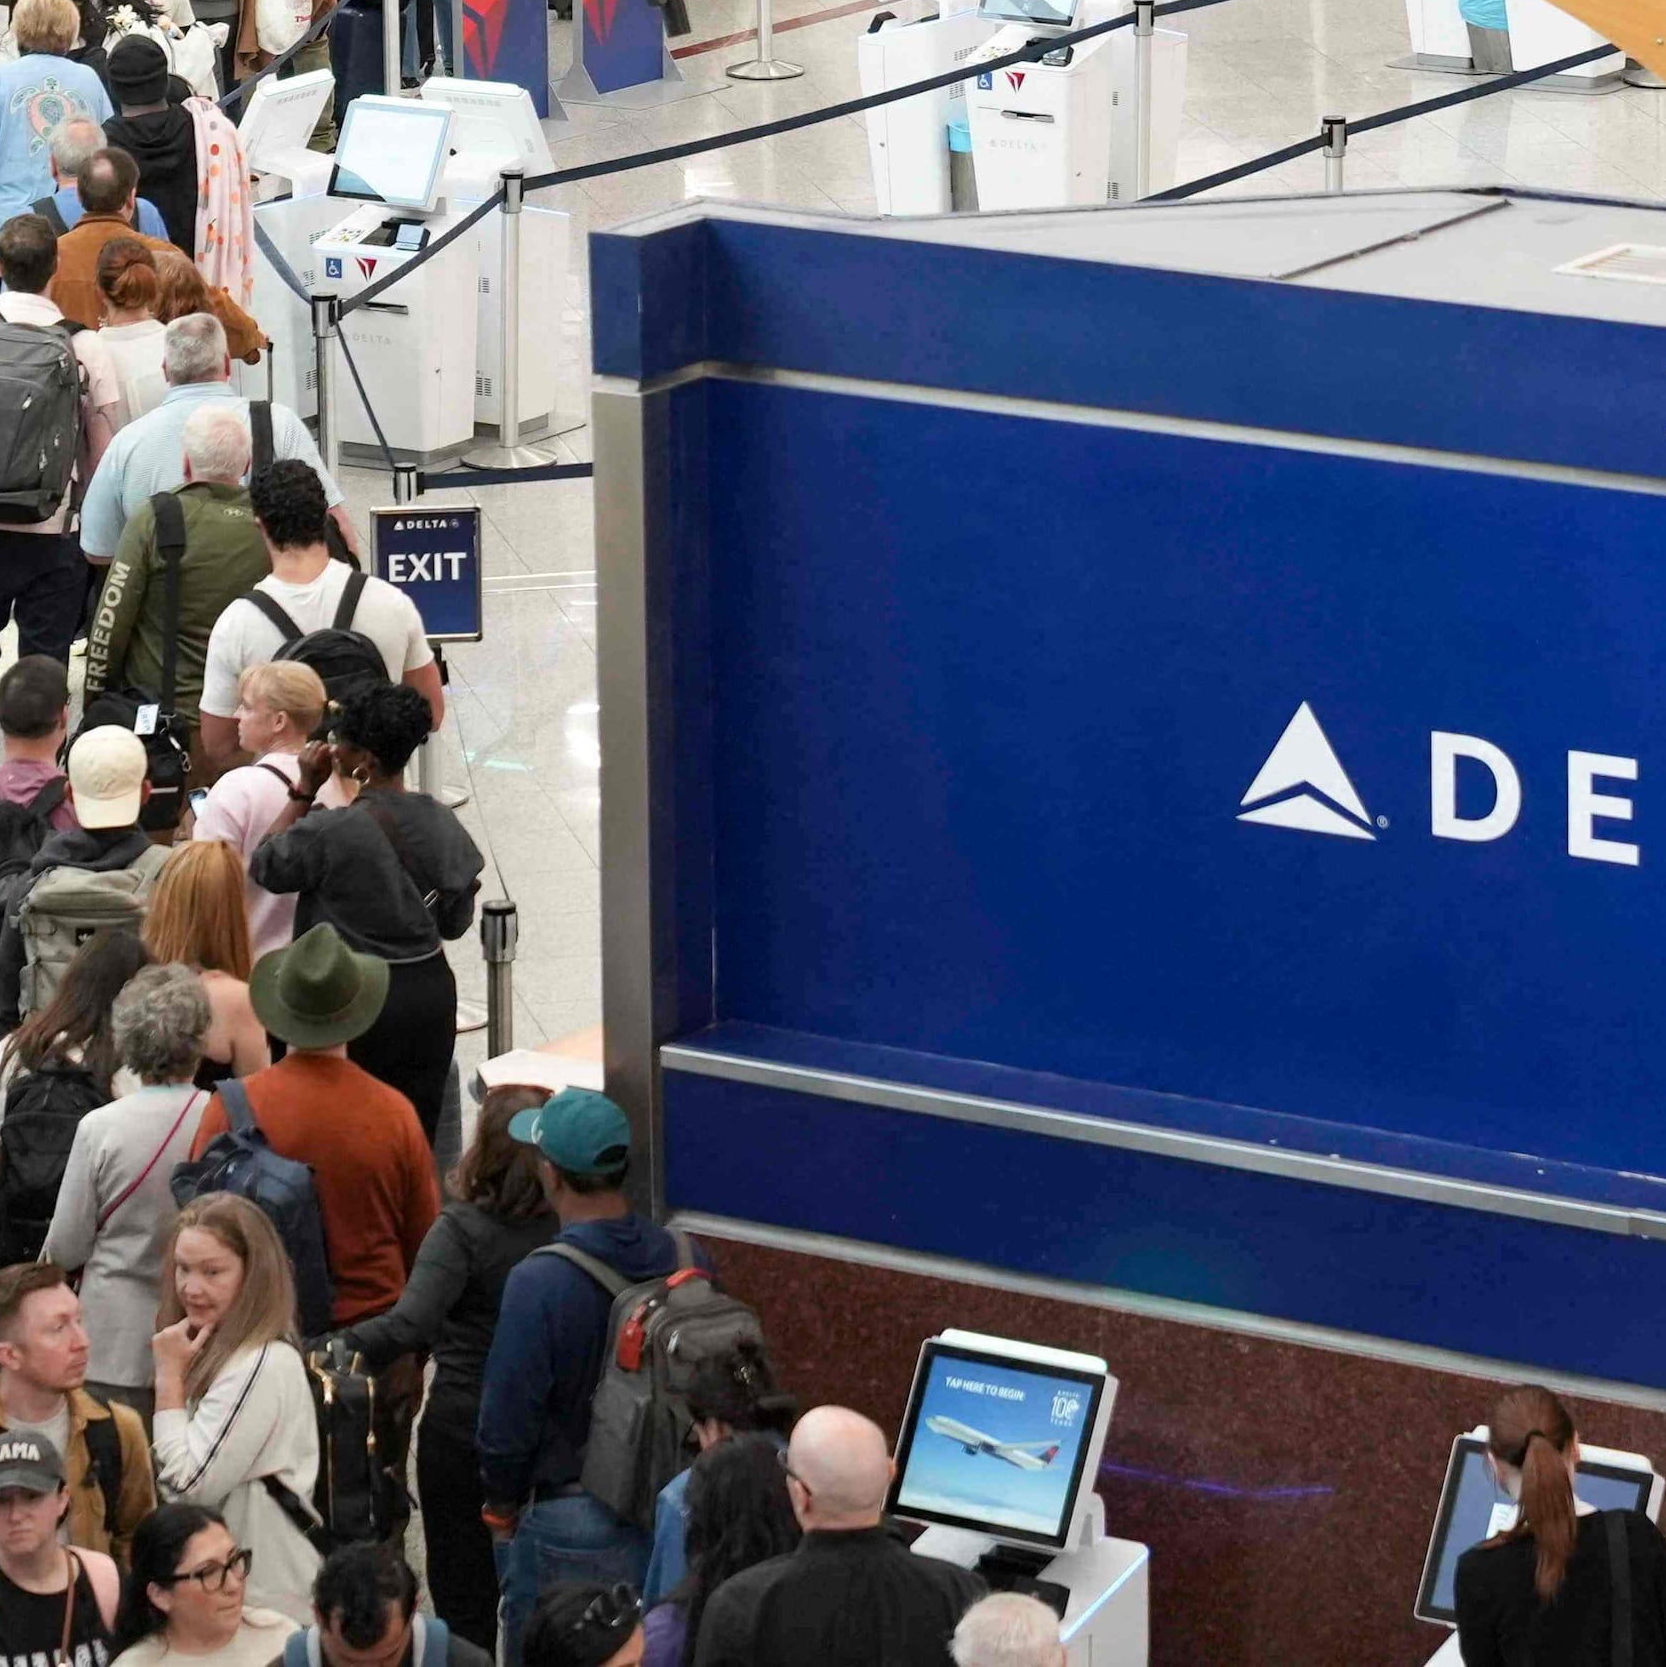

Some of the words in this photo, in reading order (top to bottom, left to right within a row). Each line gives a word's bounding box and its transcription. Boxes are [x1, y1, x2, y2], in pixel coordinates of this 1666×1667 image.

[406, 519, 448, 530] DELTA
[388, 551, 466, 583] EXIT
[86, 560, 130, 693] FREEDOM
[945, 1376, 962, 1389] TAP
[963, 1379, 985, 1394] HERE
[986, 1382, 998, 1396] TO
[998, 1385, 1025, 1401] BEGIN
